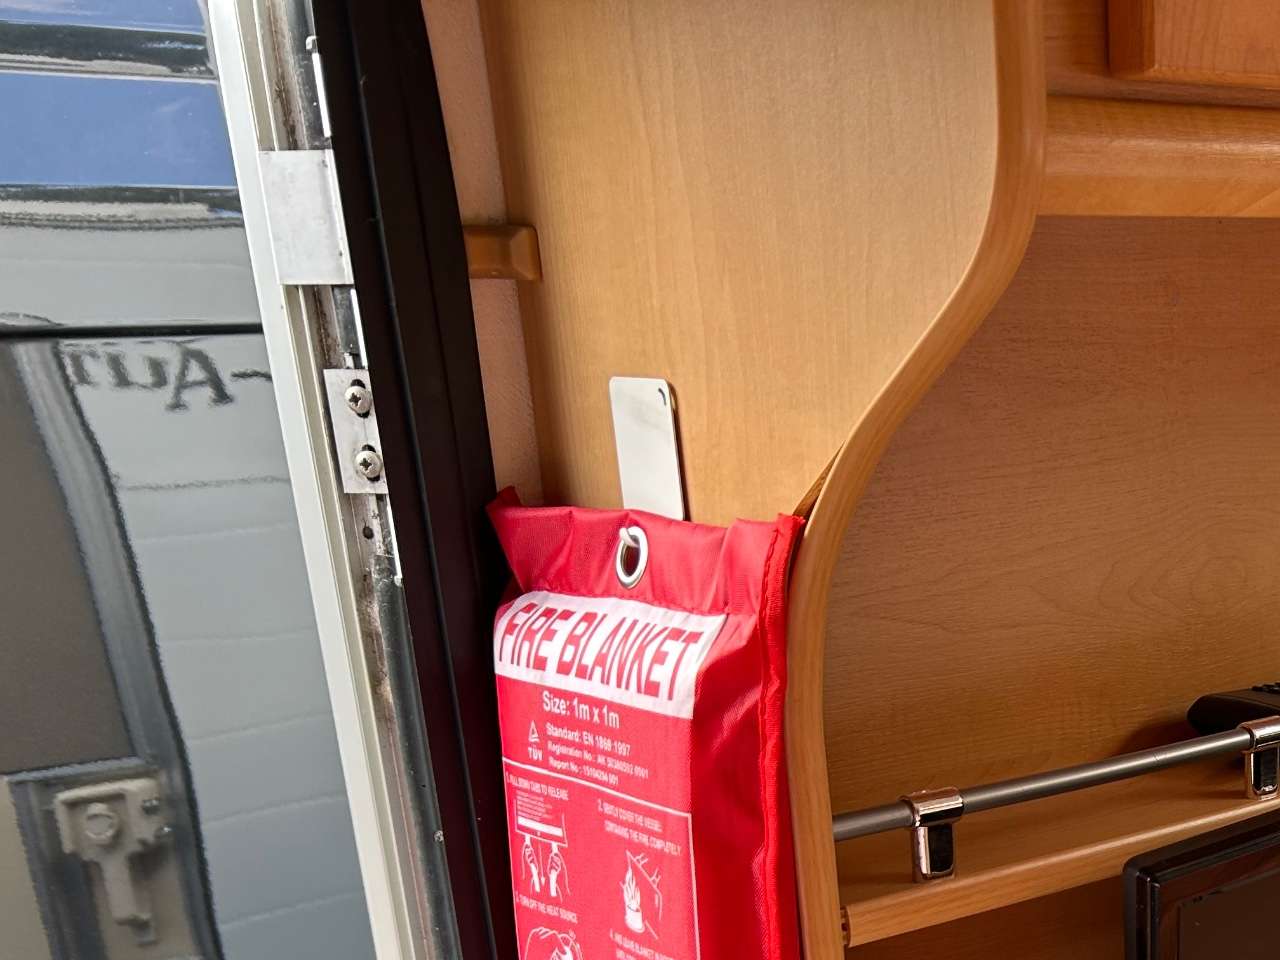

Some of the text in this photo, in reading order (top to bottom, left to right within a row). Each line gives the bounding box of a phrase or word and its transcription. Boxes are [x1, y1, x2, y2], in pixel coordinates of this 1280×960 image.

[499, 602, 705, 701] FIRE BLANKET
[542, 690, 620, 729] Size: 1m x 1m
[582, 730, 595, 747] EN
